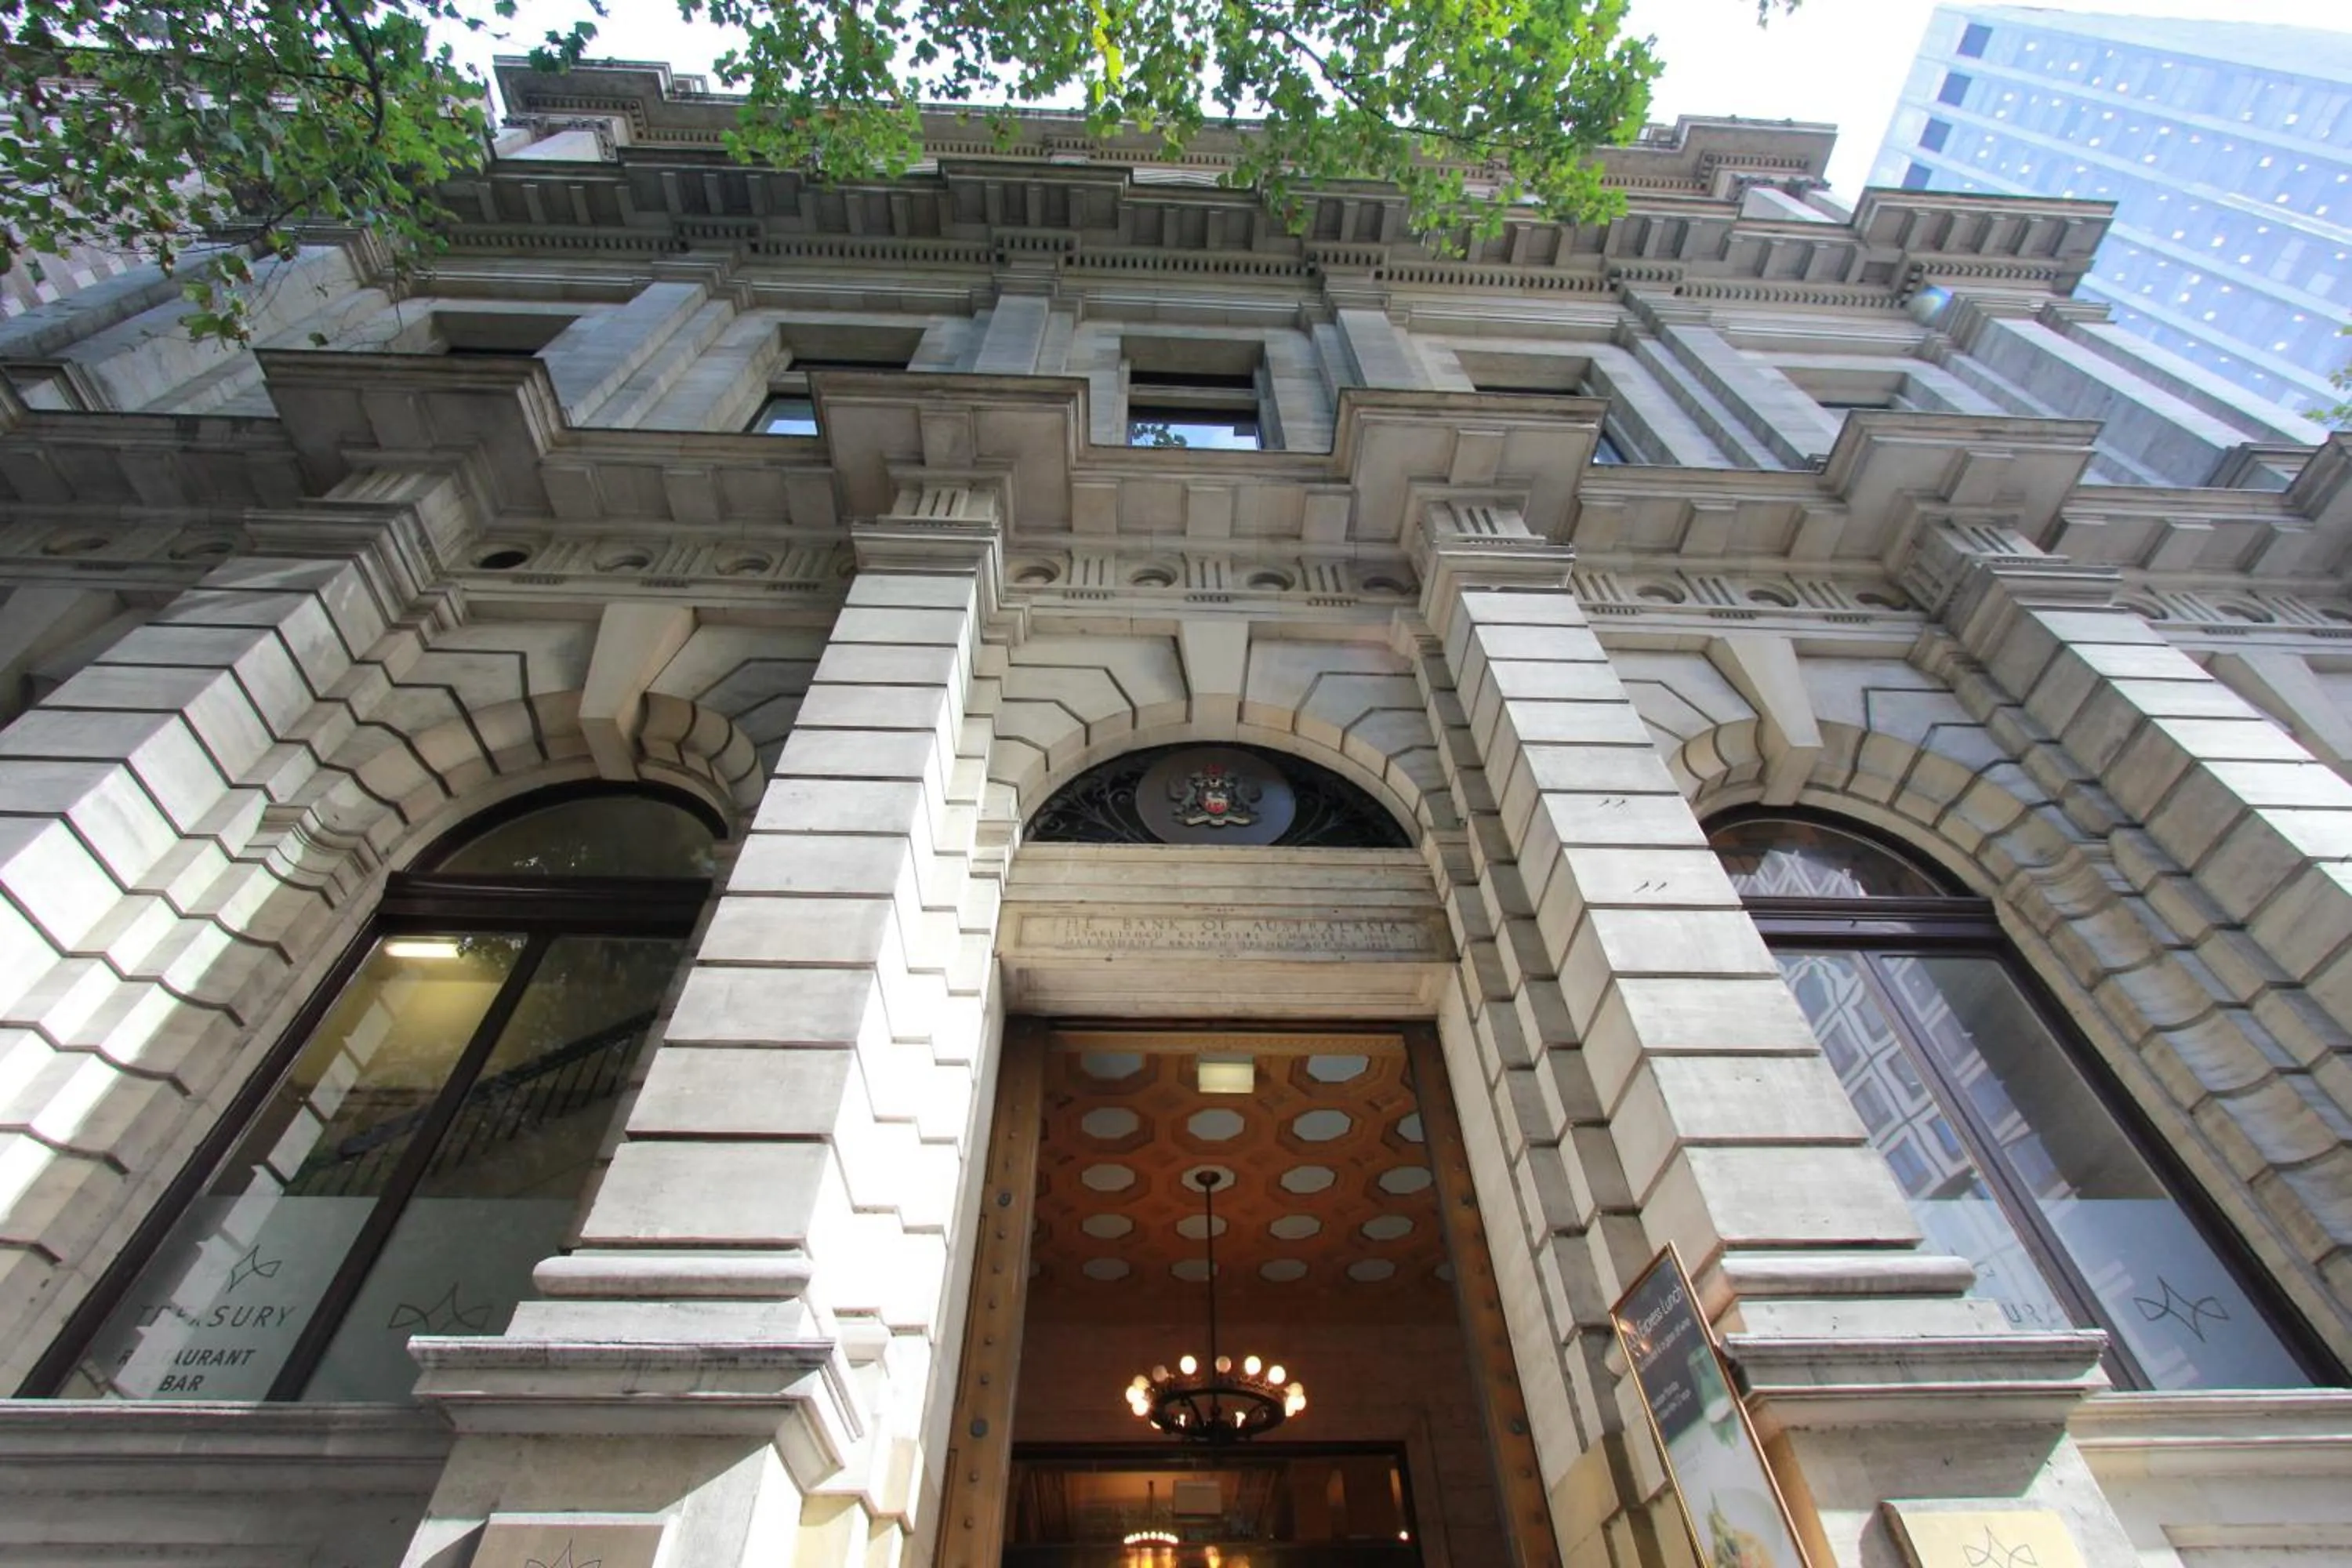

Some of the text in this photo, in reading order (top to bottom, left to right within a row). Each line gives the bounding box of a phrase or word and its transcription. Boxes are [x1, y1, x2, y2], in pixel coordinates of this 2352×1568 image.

[1053, 916, 1093, 929] HE
[1122, 916, 1179, 931] BANK
[158, 1374, 204, 1392] BAR
